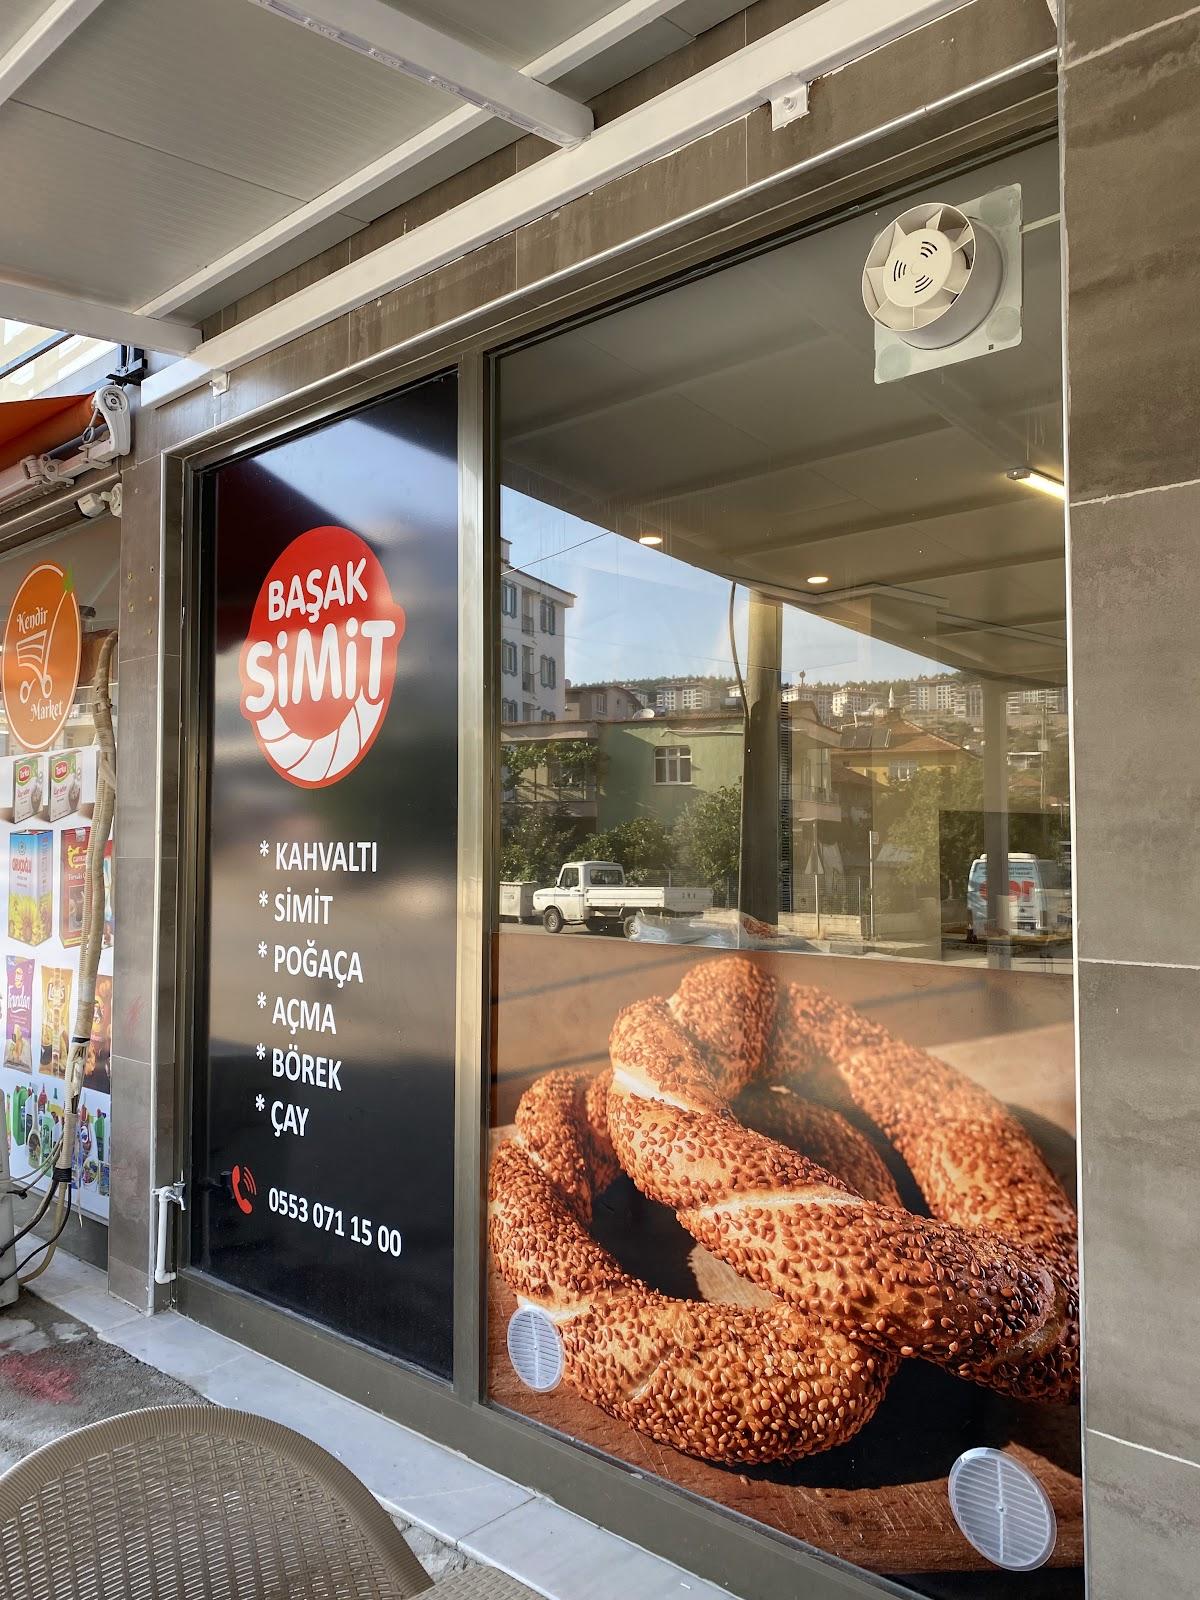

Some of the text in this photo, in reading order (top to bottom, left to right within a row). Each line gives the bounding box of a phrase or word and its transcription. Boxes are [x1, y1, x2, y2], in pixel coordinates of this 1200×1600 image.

[268, 557, 368, 623] BAŞAK
[16, 607, 49, 634] Kendir
[30, 699, 63, 722] Market
[275, 841, 378, 873] KAHVALTI
[274, 886, 334, 925] SİMİT
[273, 939, 364, 989] POĞAÇA
[271, 996, 337, 1035] AÇMA
[272, 1043, 342, 1092] BÖREK
[270, 1100, 310, 1137] ÇAY
[268, 1187, 402, 1257] 0553 071 15 00
